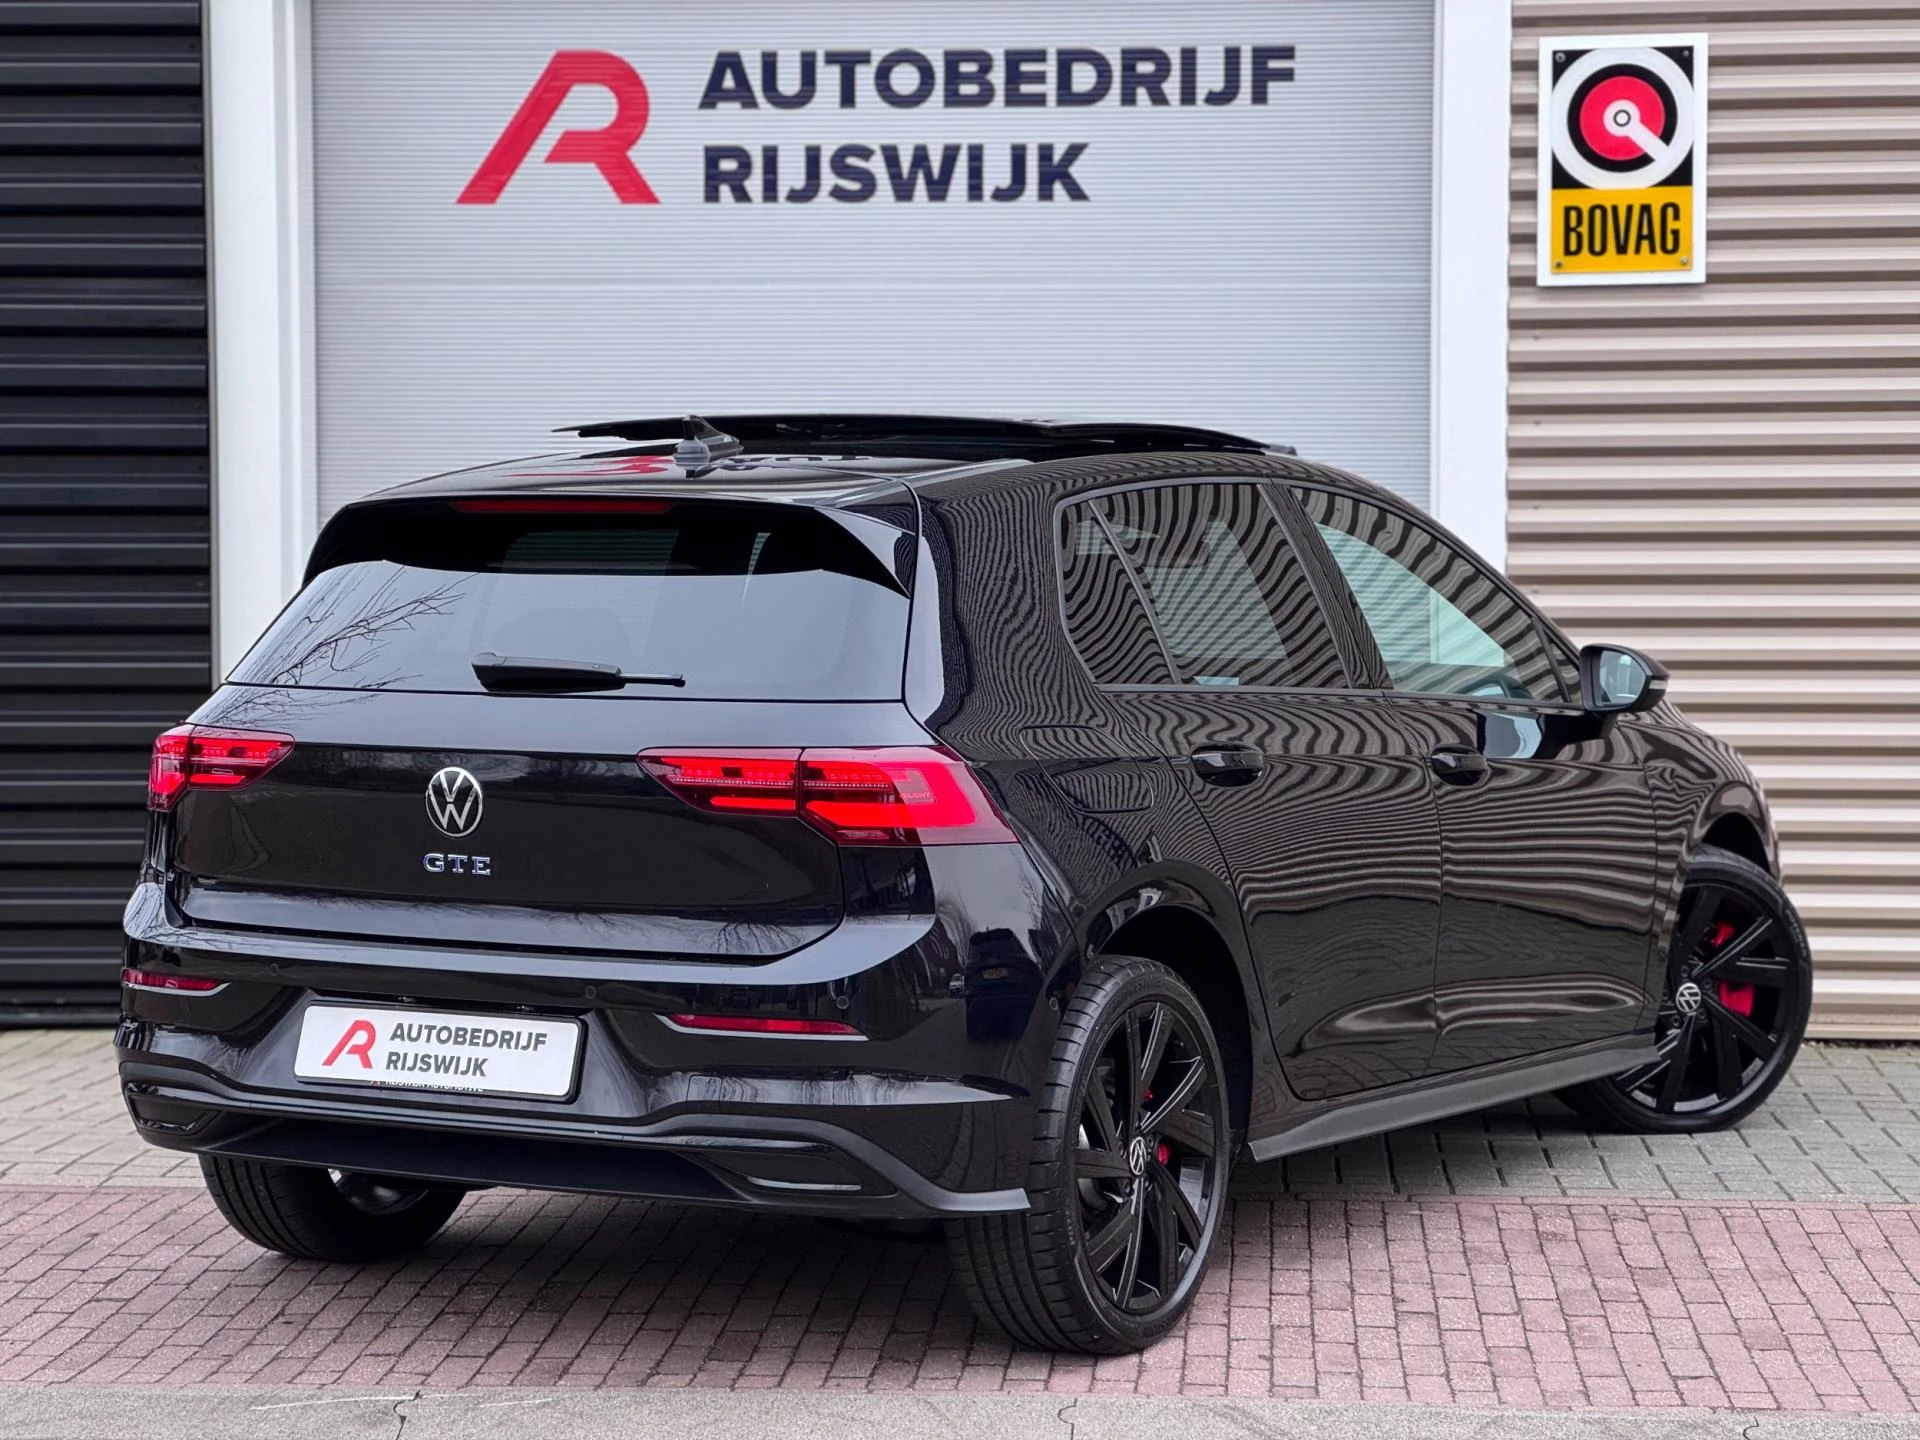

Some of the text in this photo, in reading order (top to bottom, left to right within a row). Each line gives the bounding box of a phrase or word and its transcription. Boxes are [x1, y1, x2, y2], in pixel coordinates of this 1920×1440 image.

[698, 46, 1296, 110] AUTOBEDRIJF
[703, 143, 1091, 203] RIJSWIJK
[1563, 202, 1680, 257] BOVAG
[423, 852, 491, 876] GTE
[389, 1022, 547, 1051] AUTOBEDRIJF
[385, 1051, 488, 1077] RIJSWIJK
